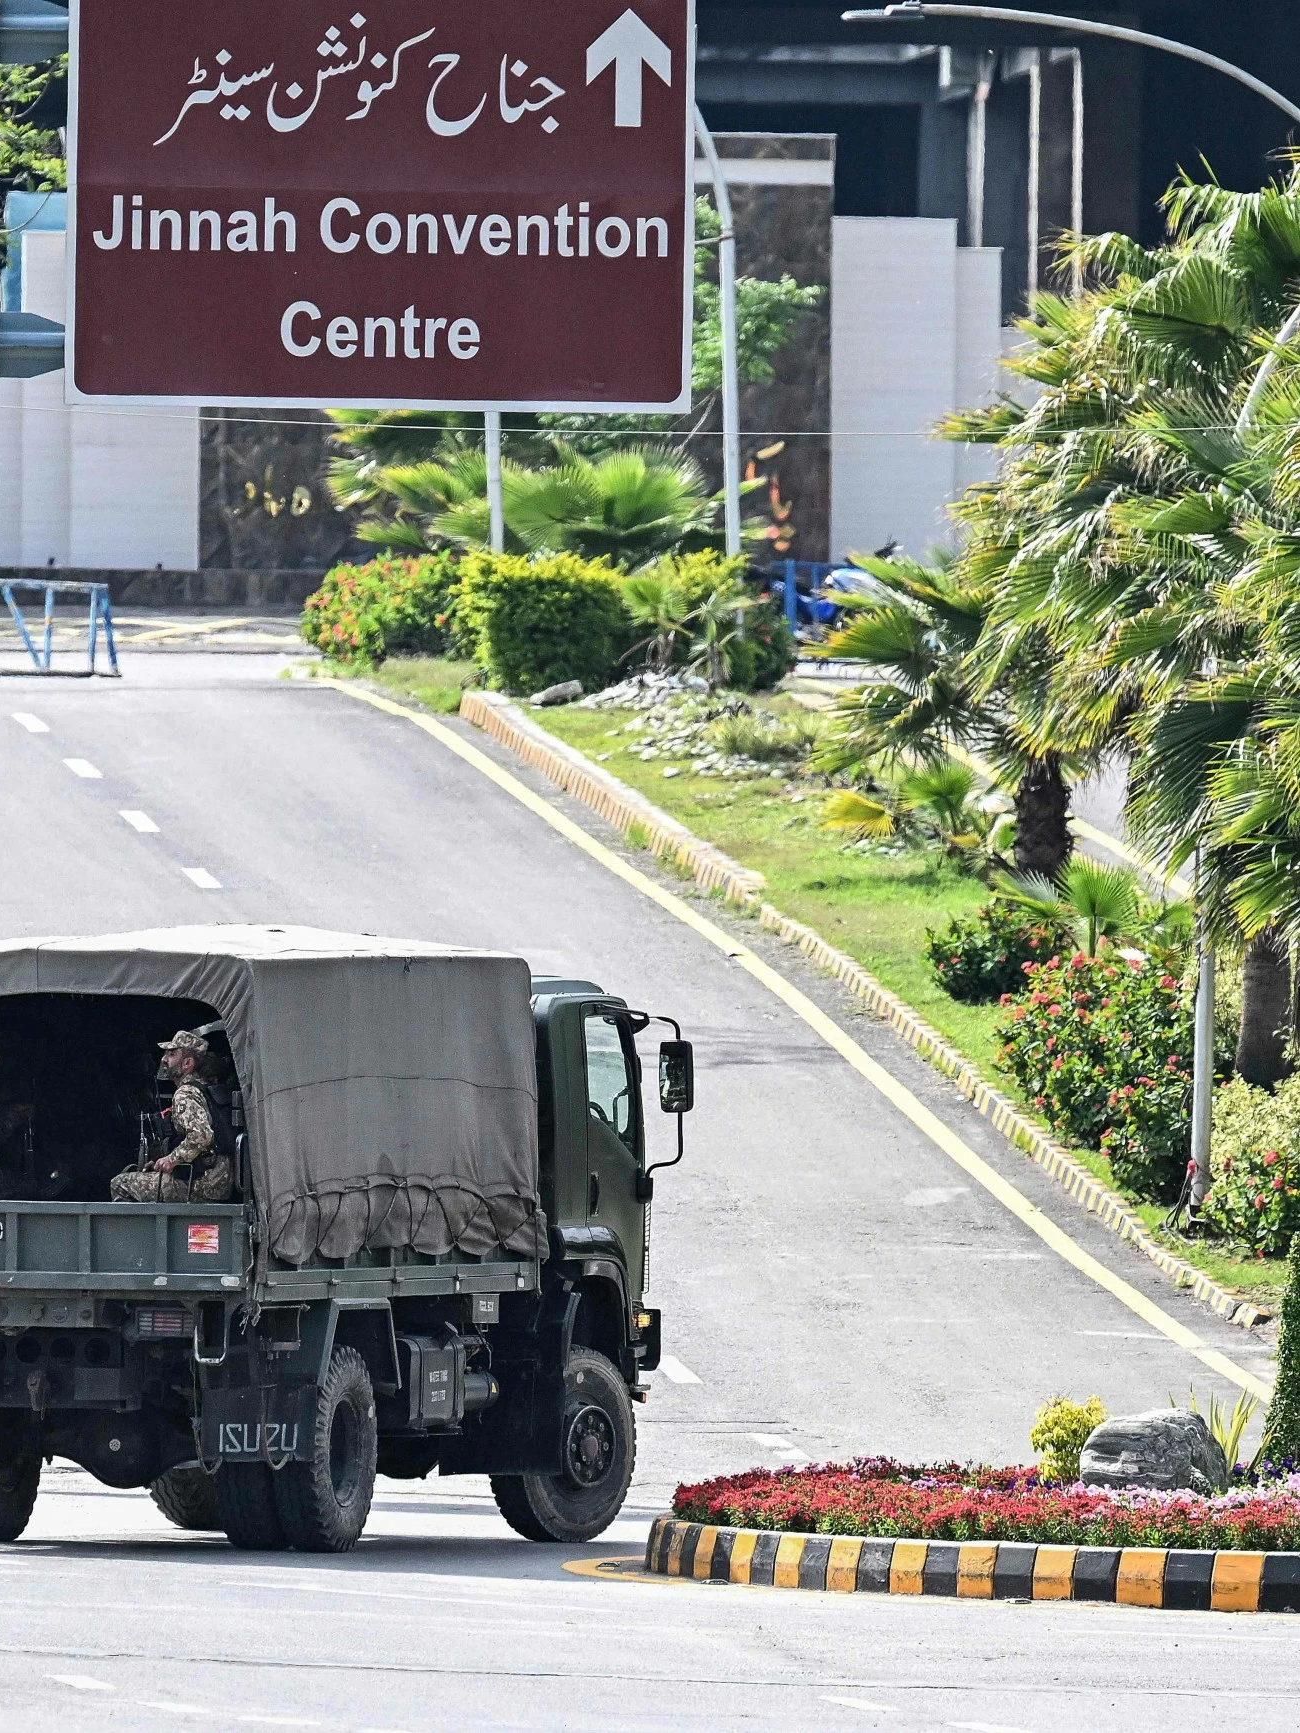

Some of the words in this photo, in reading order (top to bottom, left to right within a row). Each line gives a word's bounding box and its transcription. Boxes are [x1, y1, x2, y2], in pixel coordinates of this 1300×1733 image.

[153, 48, 275, 146] سینٹر
[267, 12, 436, 133] کنونشن
[426, 53, 566, 137] جناح
[92, 194, 297, 252] Jinnah
[319, 197, 668, 258] Convention
[280, 300, 481, 360] Centre
[218, 1423, 299, 1453] ISUZU
